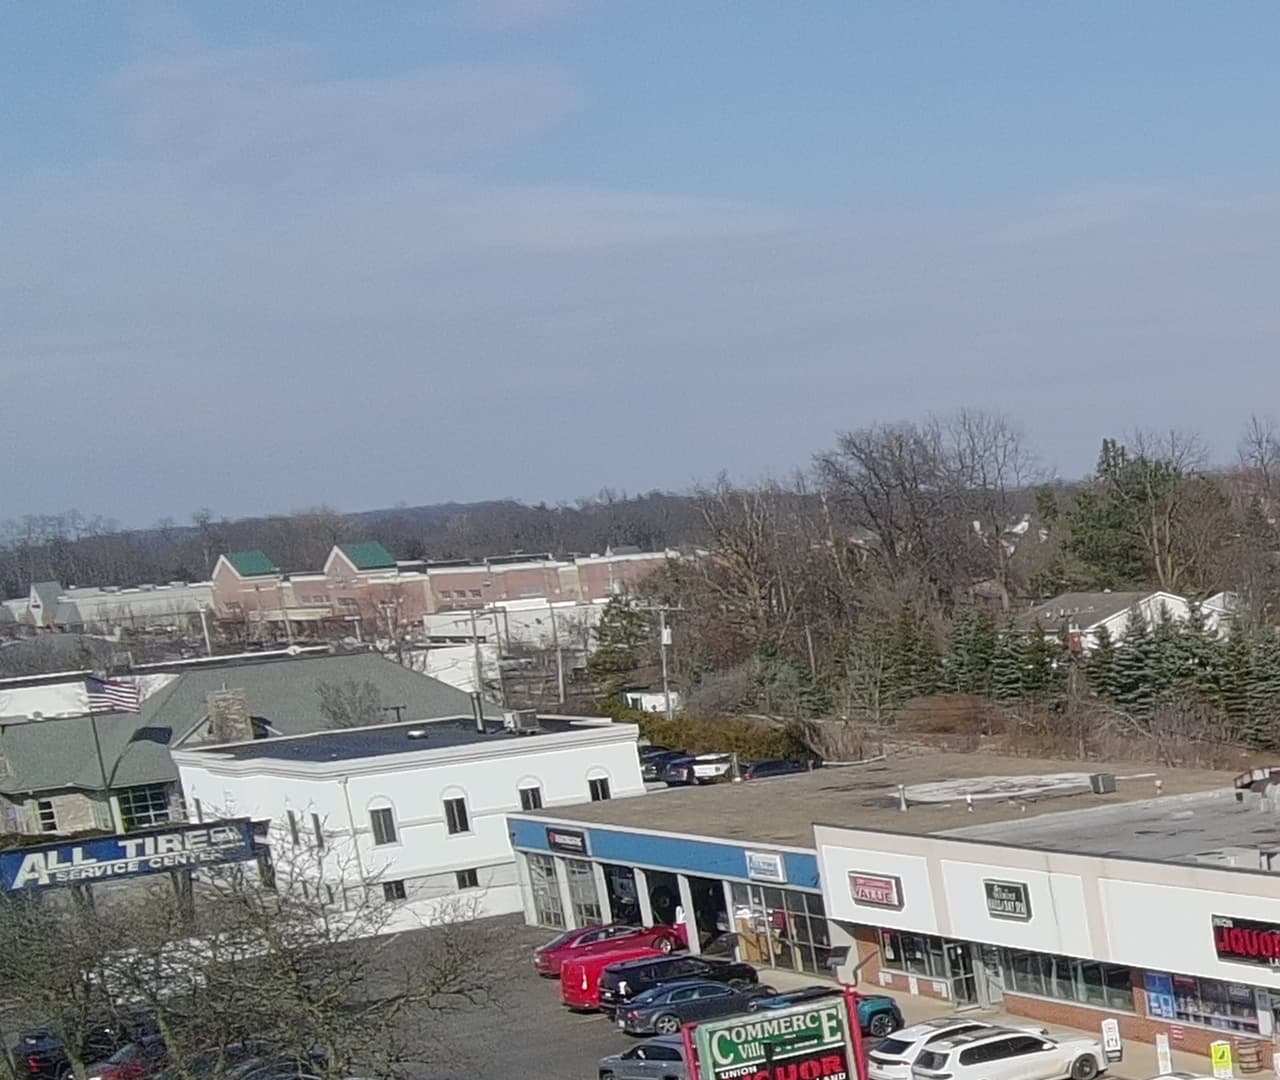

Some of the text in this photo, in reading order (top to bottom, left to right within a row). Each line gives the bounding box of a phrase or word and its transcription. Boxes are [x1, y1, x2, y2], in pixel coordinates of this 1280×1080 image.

[11, 829, 207, 889] ALL TIRE
[56, 851, 225, 882] SERVICE CENTER
[711, 1008, 842, 1065] COMMERCE
[720, 1066, 757, 1079] UNION
